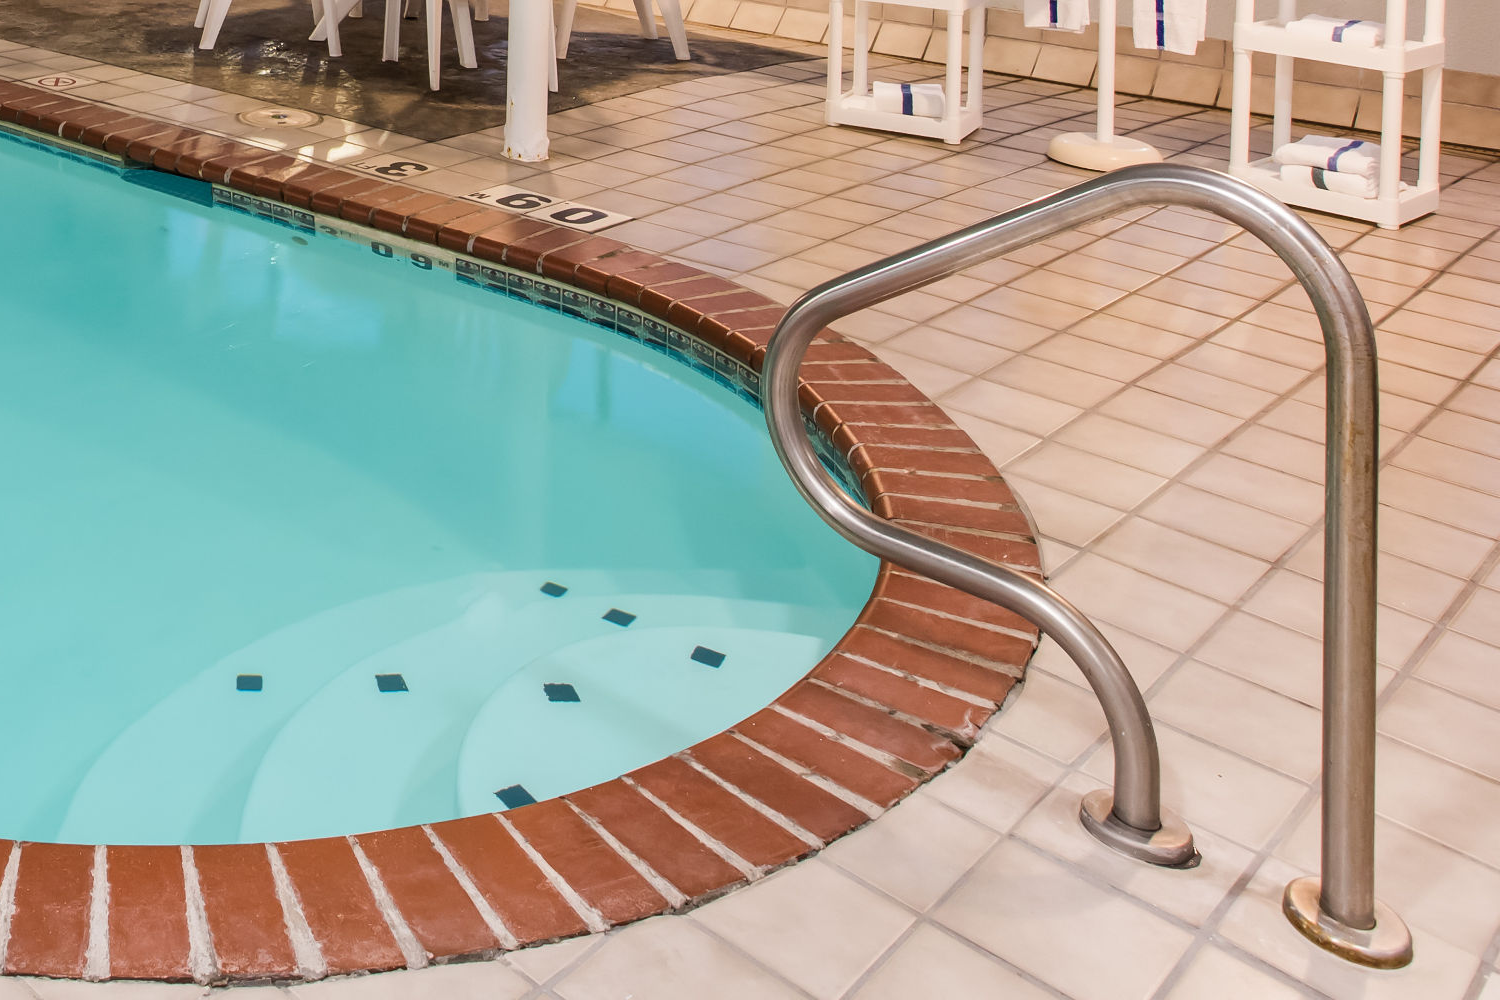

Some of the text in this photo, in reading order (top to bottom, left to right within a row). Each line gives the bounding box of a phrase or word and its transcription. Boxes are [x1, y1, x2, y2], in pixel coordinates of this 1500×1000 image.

[348, 161, 429, 177] 3 FT
[467, 192, 609, 225] 0.9 M
